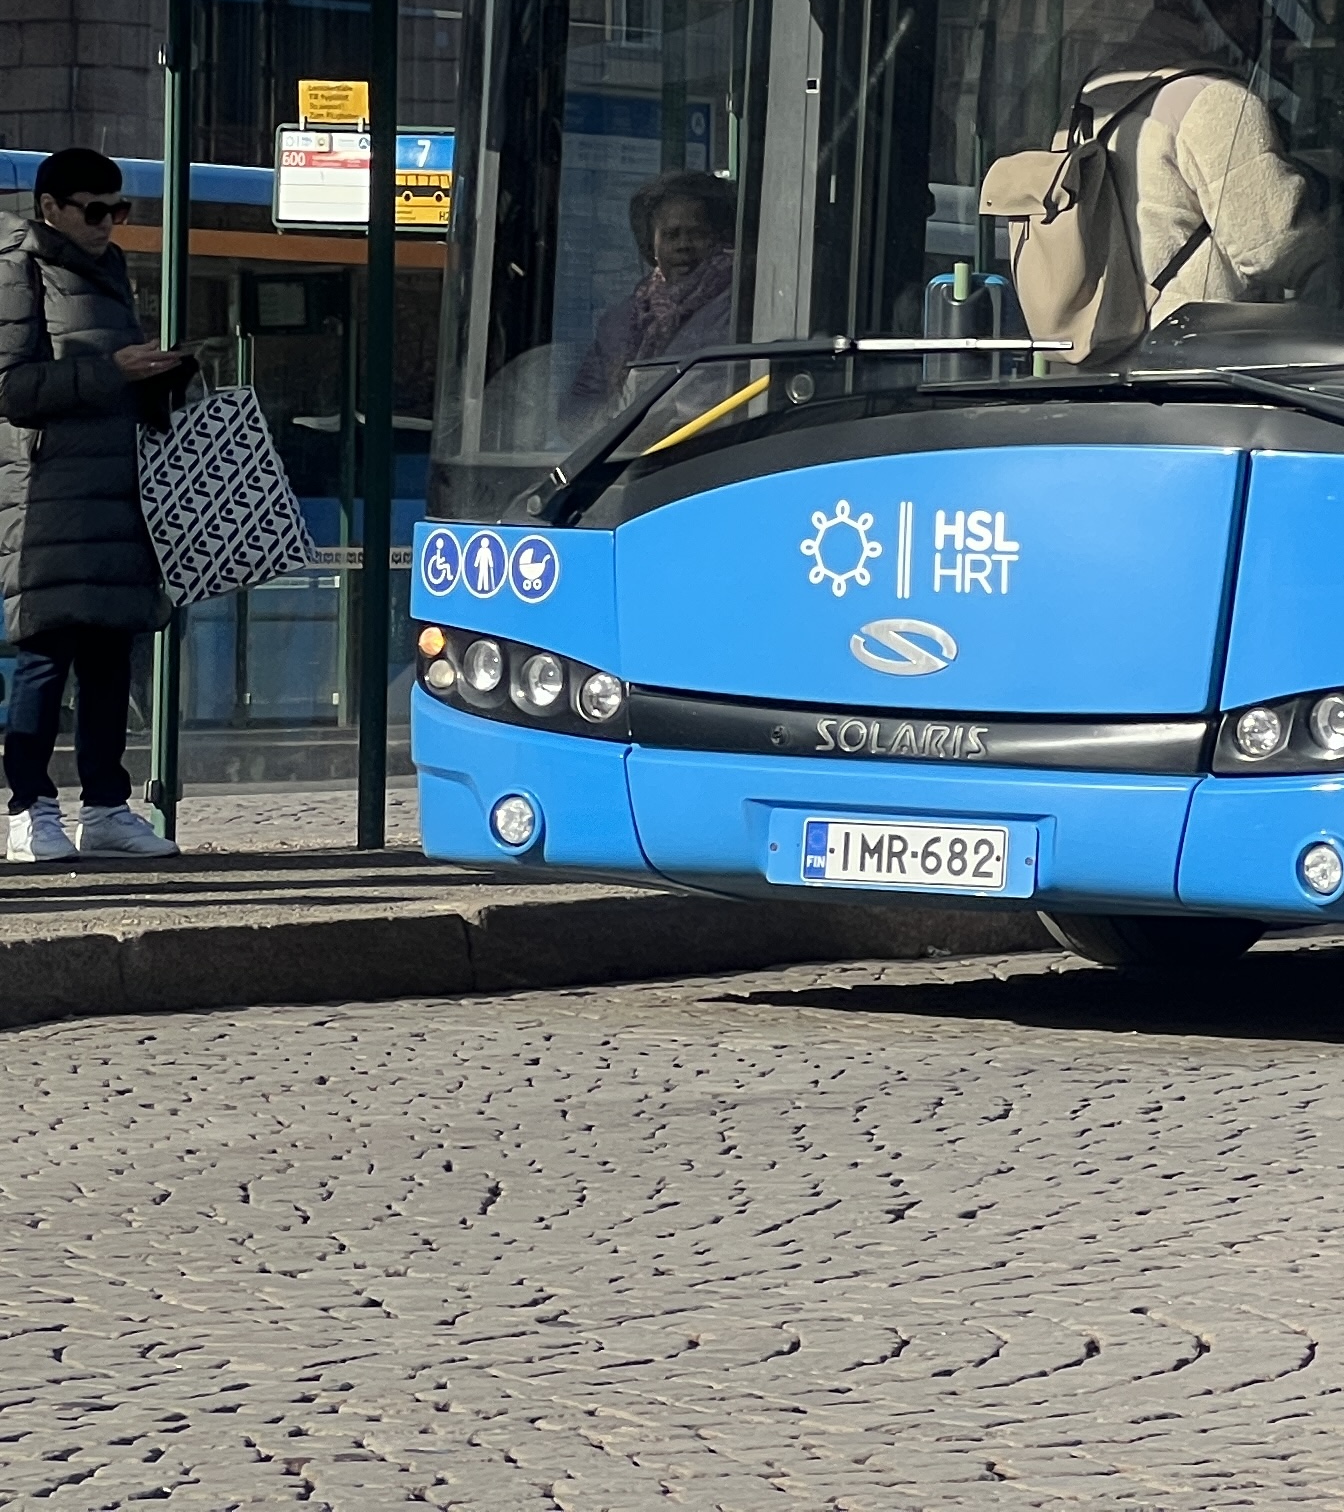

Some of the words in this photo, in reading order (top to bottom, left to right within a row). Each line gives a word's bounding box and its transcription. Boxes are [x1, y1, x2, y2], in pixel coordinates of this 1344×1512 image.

[281, 152, 306, 166] 600
[417, 139, 431, 168] 7
[934, 510, 1019, 553] HSL
[933, 551, 1020, 595] HRT
[815, 717, 989, 760] SOLARIS
[806, 855, 825, 868] FIN
[841, 831, 995, 878] IMR-682
